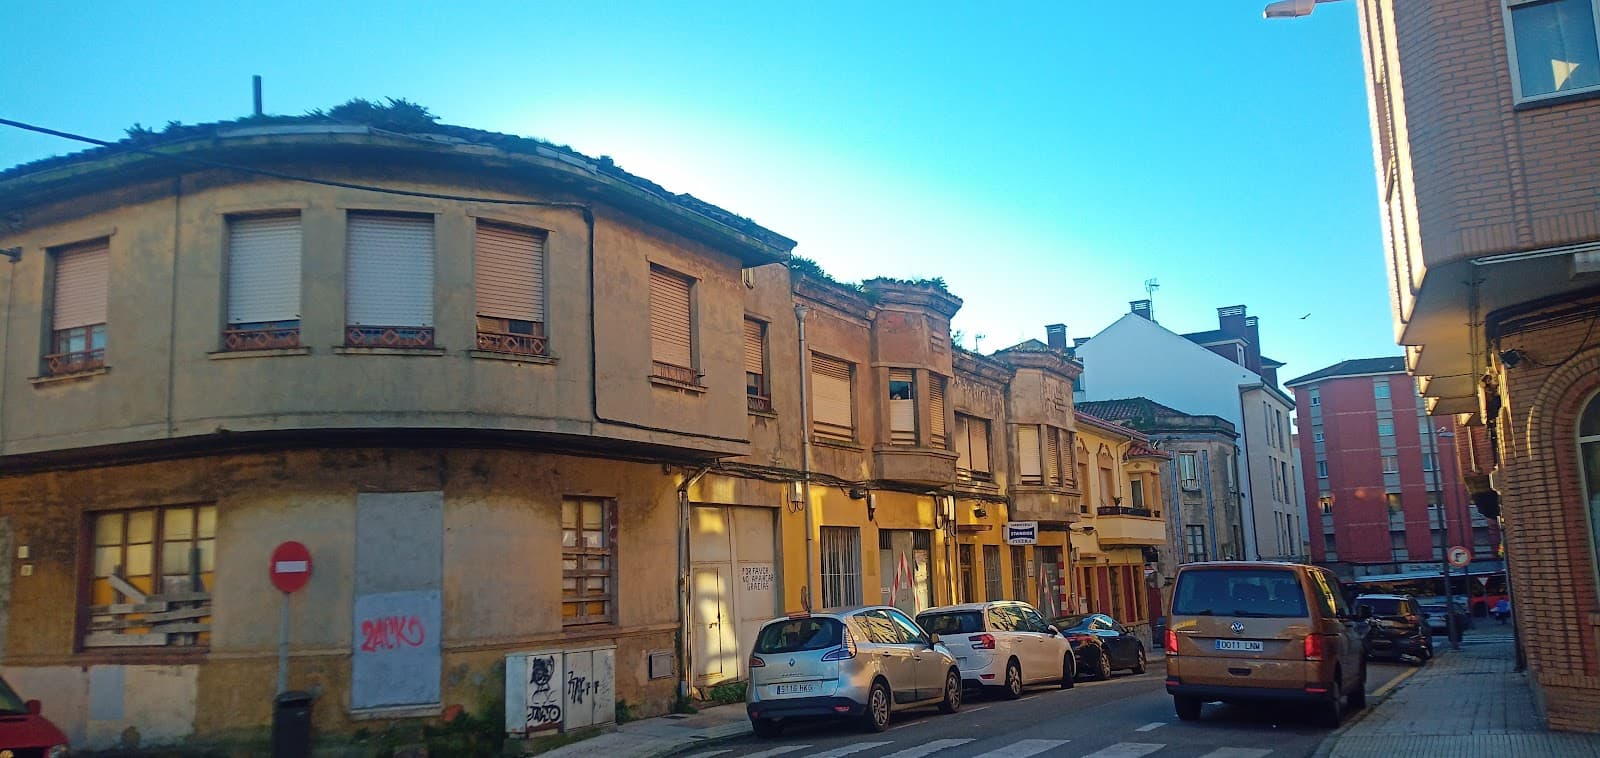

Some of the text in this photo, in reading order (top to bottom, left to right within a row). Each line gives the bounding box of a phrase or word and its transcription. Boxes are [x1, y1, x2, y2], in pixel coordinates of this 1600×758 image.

[742, 567, 769, 575] POR FAVOR
[742, 573, 774, 583] NO APARCAR
[746, 582, 769, 591] GRACIAS
[1221, 641, 1240, 649] 0011
